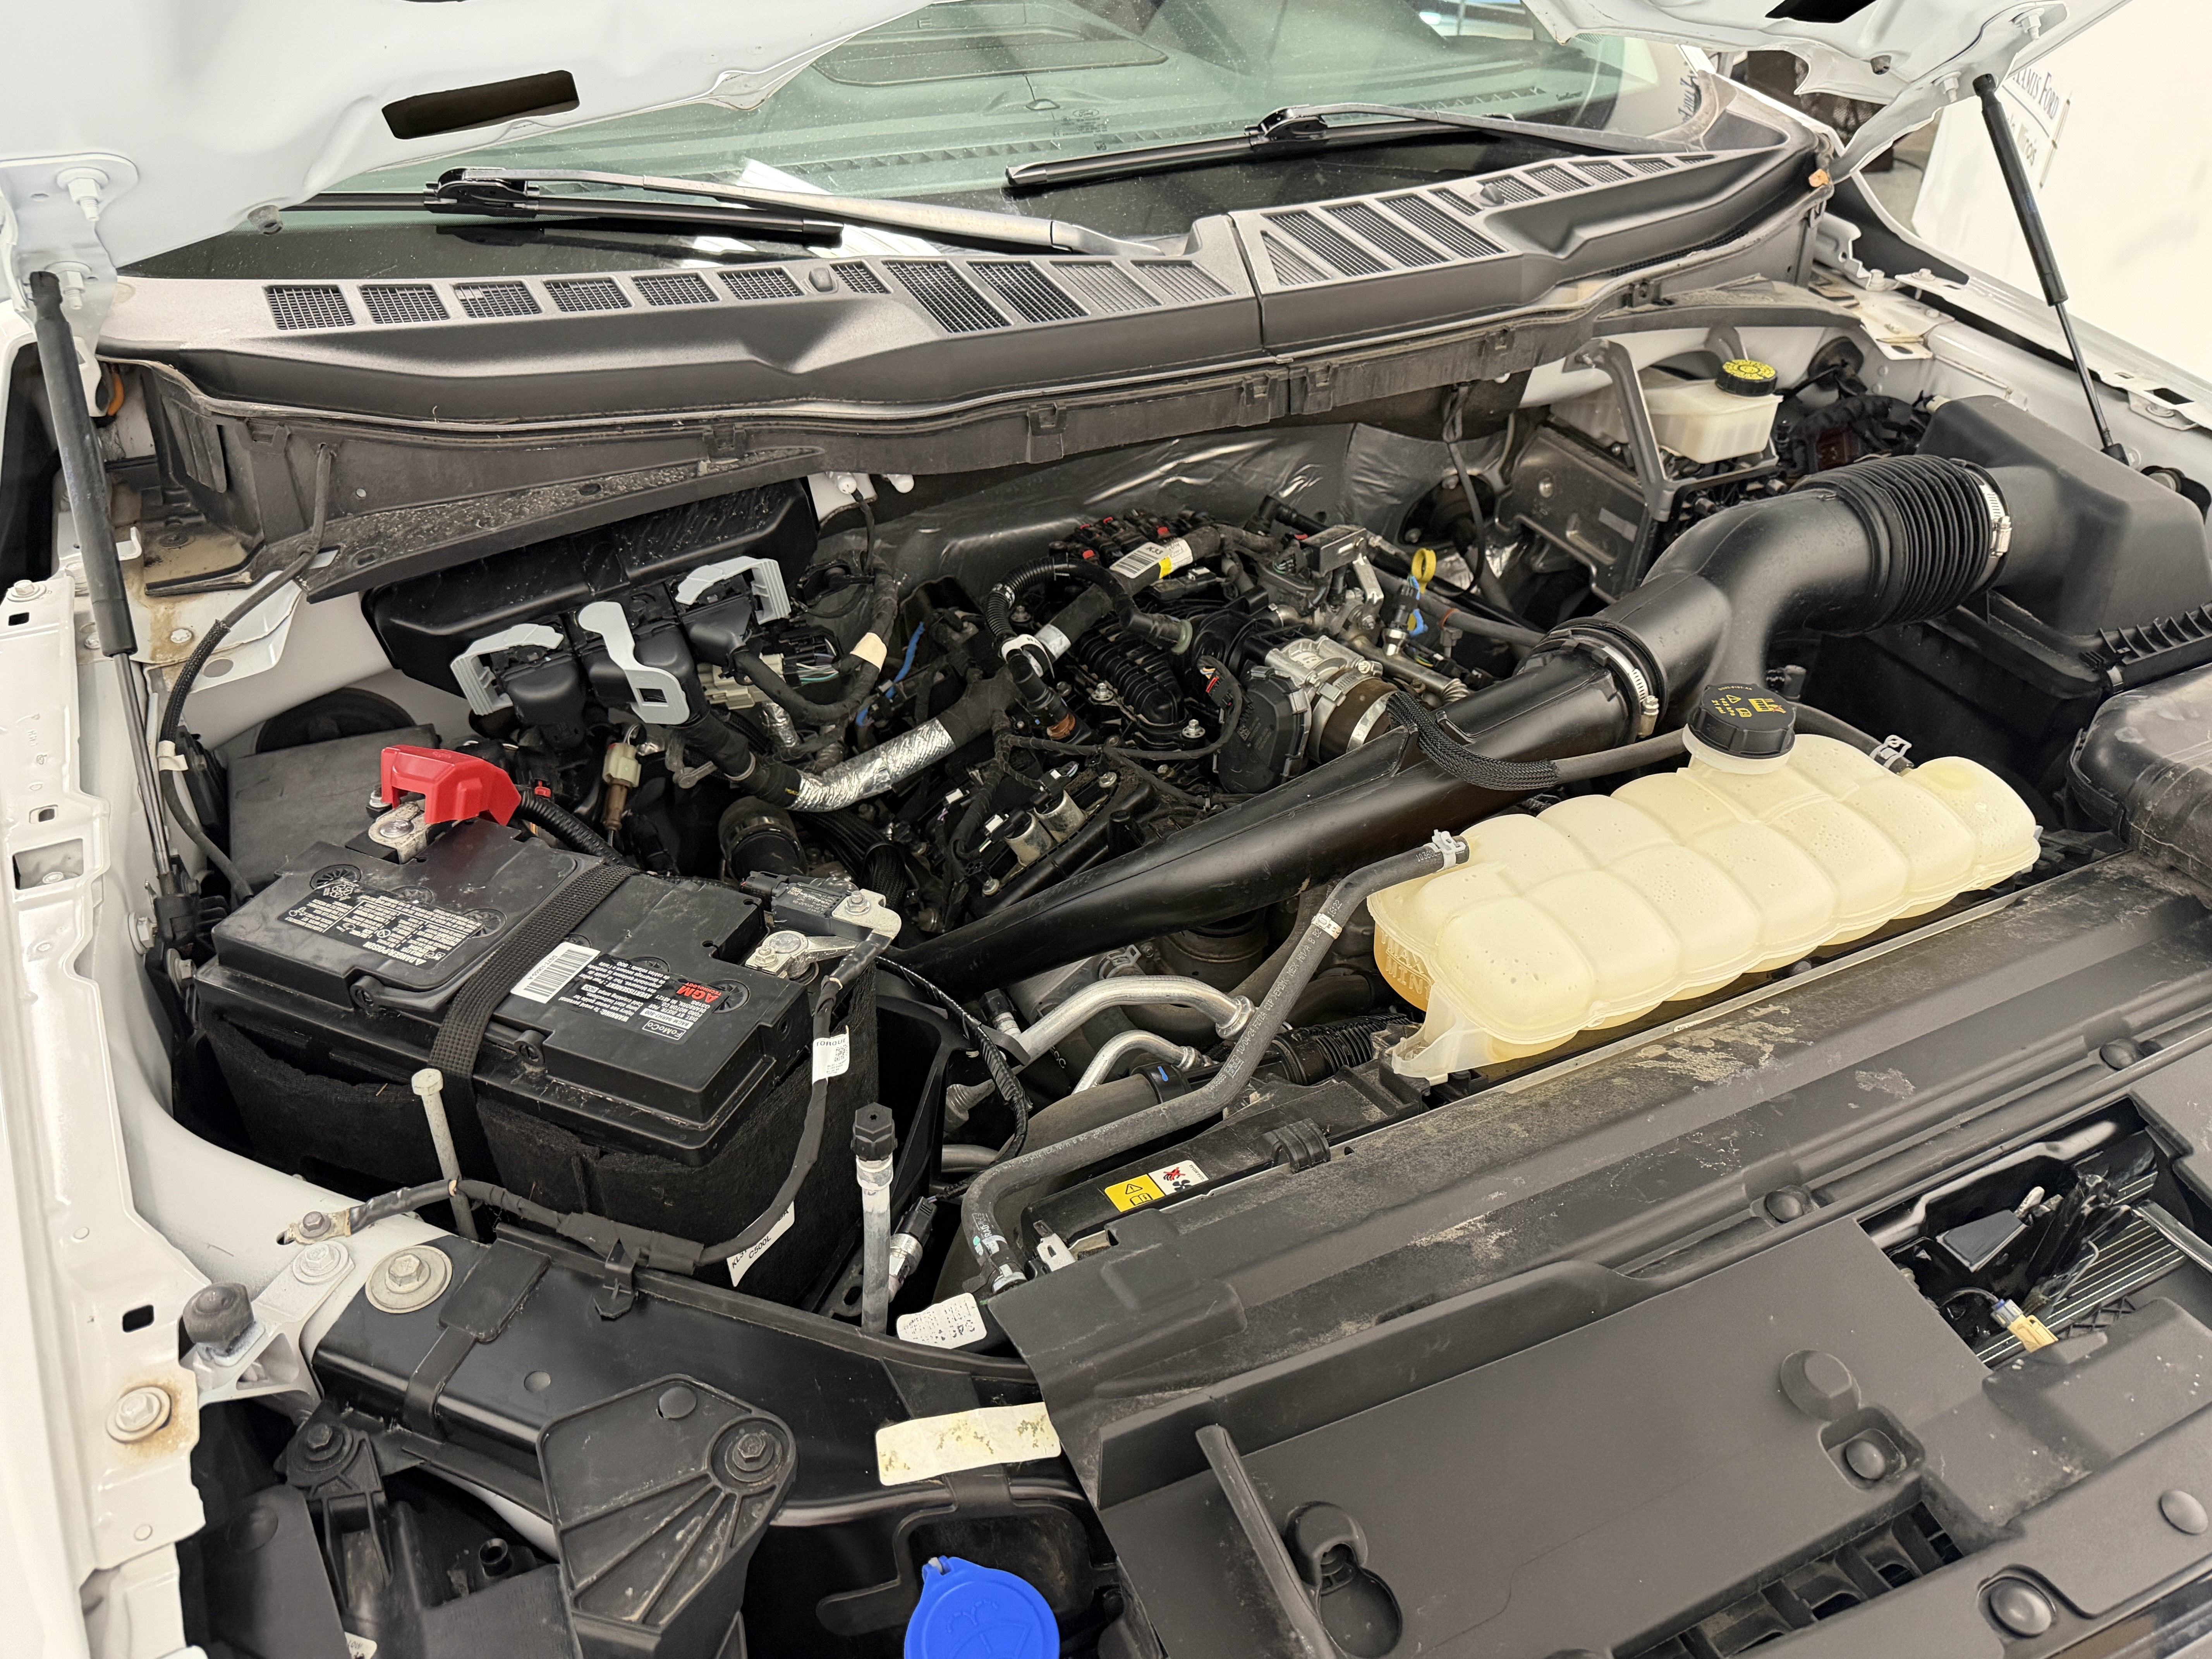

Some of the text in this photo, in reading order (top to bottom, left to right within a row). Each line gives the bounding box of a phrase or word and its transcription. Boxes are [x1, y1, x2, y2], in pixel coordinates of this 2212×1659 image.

[362, 941, 417, 963] DANGER/POISON
[605, 981, 653, 999] AVERTISSEMENT
[675, 985, 720, 1004] AGM
[684, 982, 723, 995] TECHNOLOGY
[558, 995, 581, 1006] personal
[598, 1008, 630, 1022] WARNING:
[668, 1004, 689, 1013] MOTOR
[645, 1022, 683, 1037] FoMoCo
[749, 1236, 771, 1259] C500L
